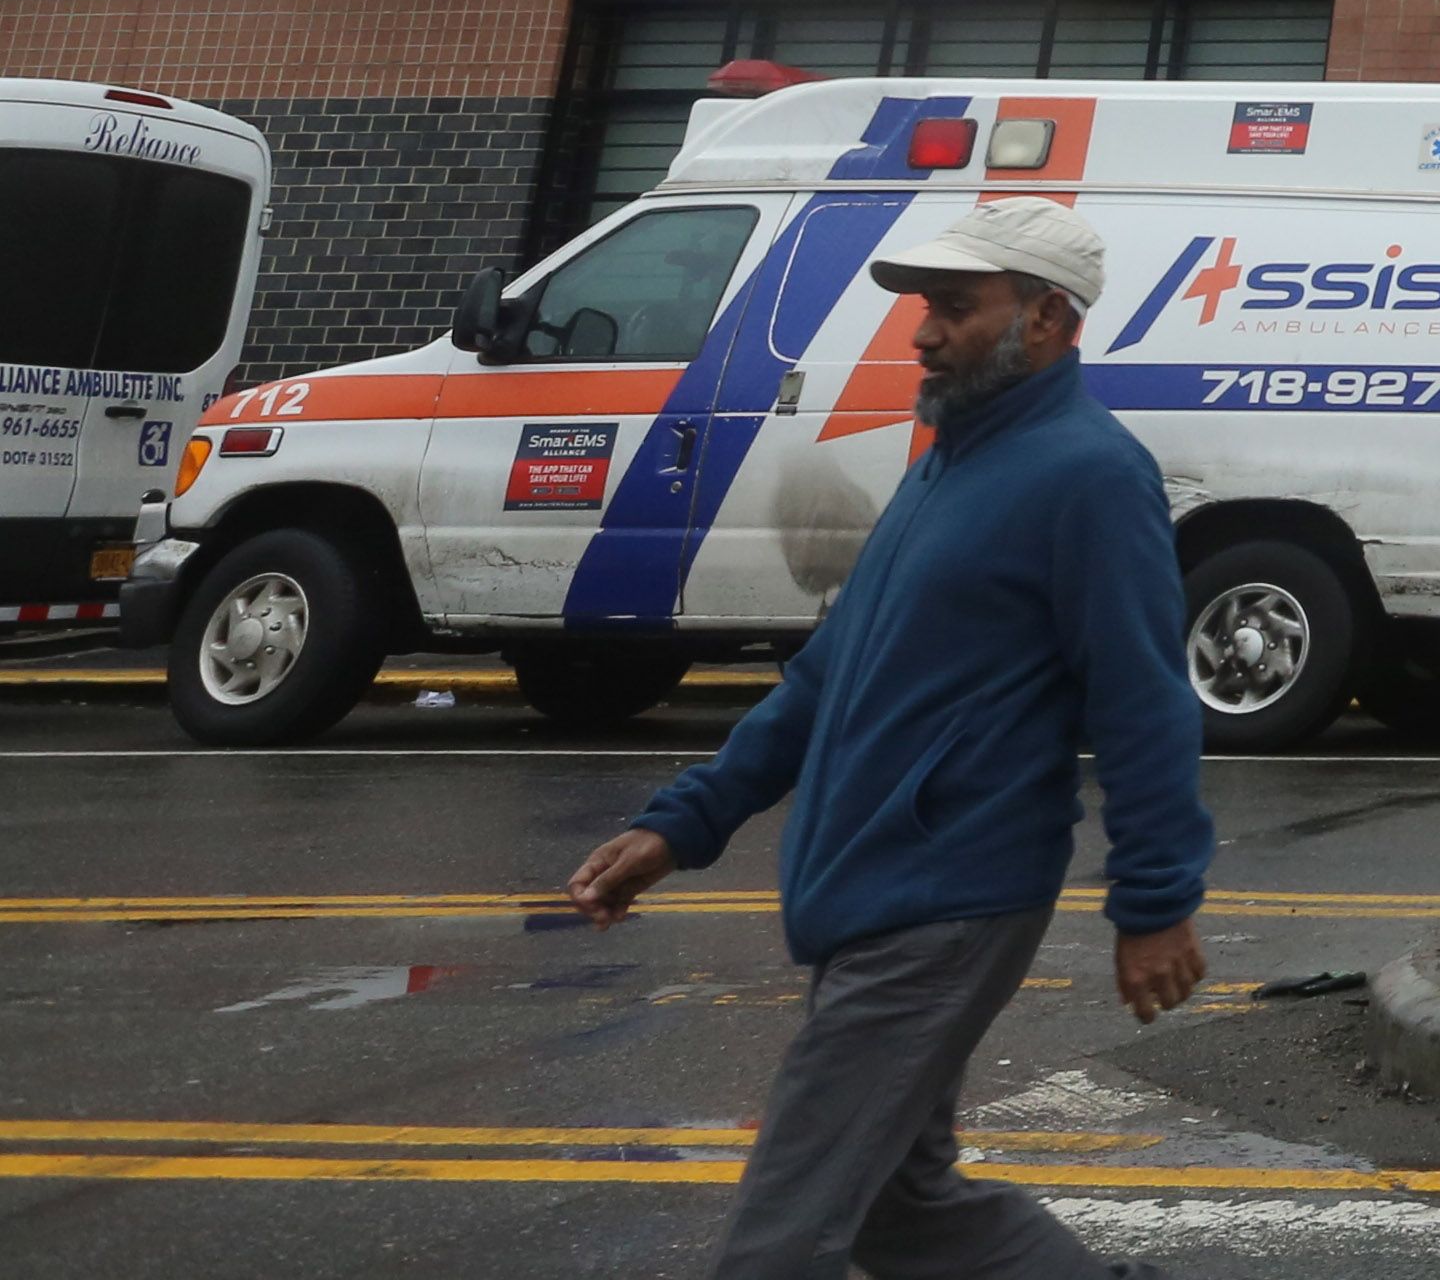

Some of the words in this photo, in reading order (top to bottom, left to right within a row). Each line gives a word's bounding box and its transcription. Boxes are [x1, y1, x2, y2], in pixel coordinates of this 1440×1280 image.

[84, 111, 202, 165] Reliance
[63, 369, 154, 401] AMBULETTE
[156, 374, 185, 403] INC.
[229, 382, 311, 419] 712
[2, 416, 80, 439] 961-6655
[3, 451, 36, 466] DOT#
[39, 451, 73, 467] 31522
[542, 449, 588, 457] ALLIANCE
[529, 464, 543, 474] THE
[542, 464, 559, 474] APP
[559, 464, 578, 474] THAT
[578, 464, 594, 474] CAN
[530, 474, 549, 483] SAVE
[549, 474, 569, 483] YOUR
[568, 474, 588, 483] LIFE!
